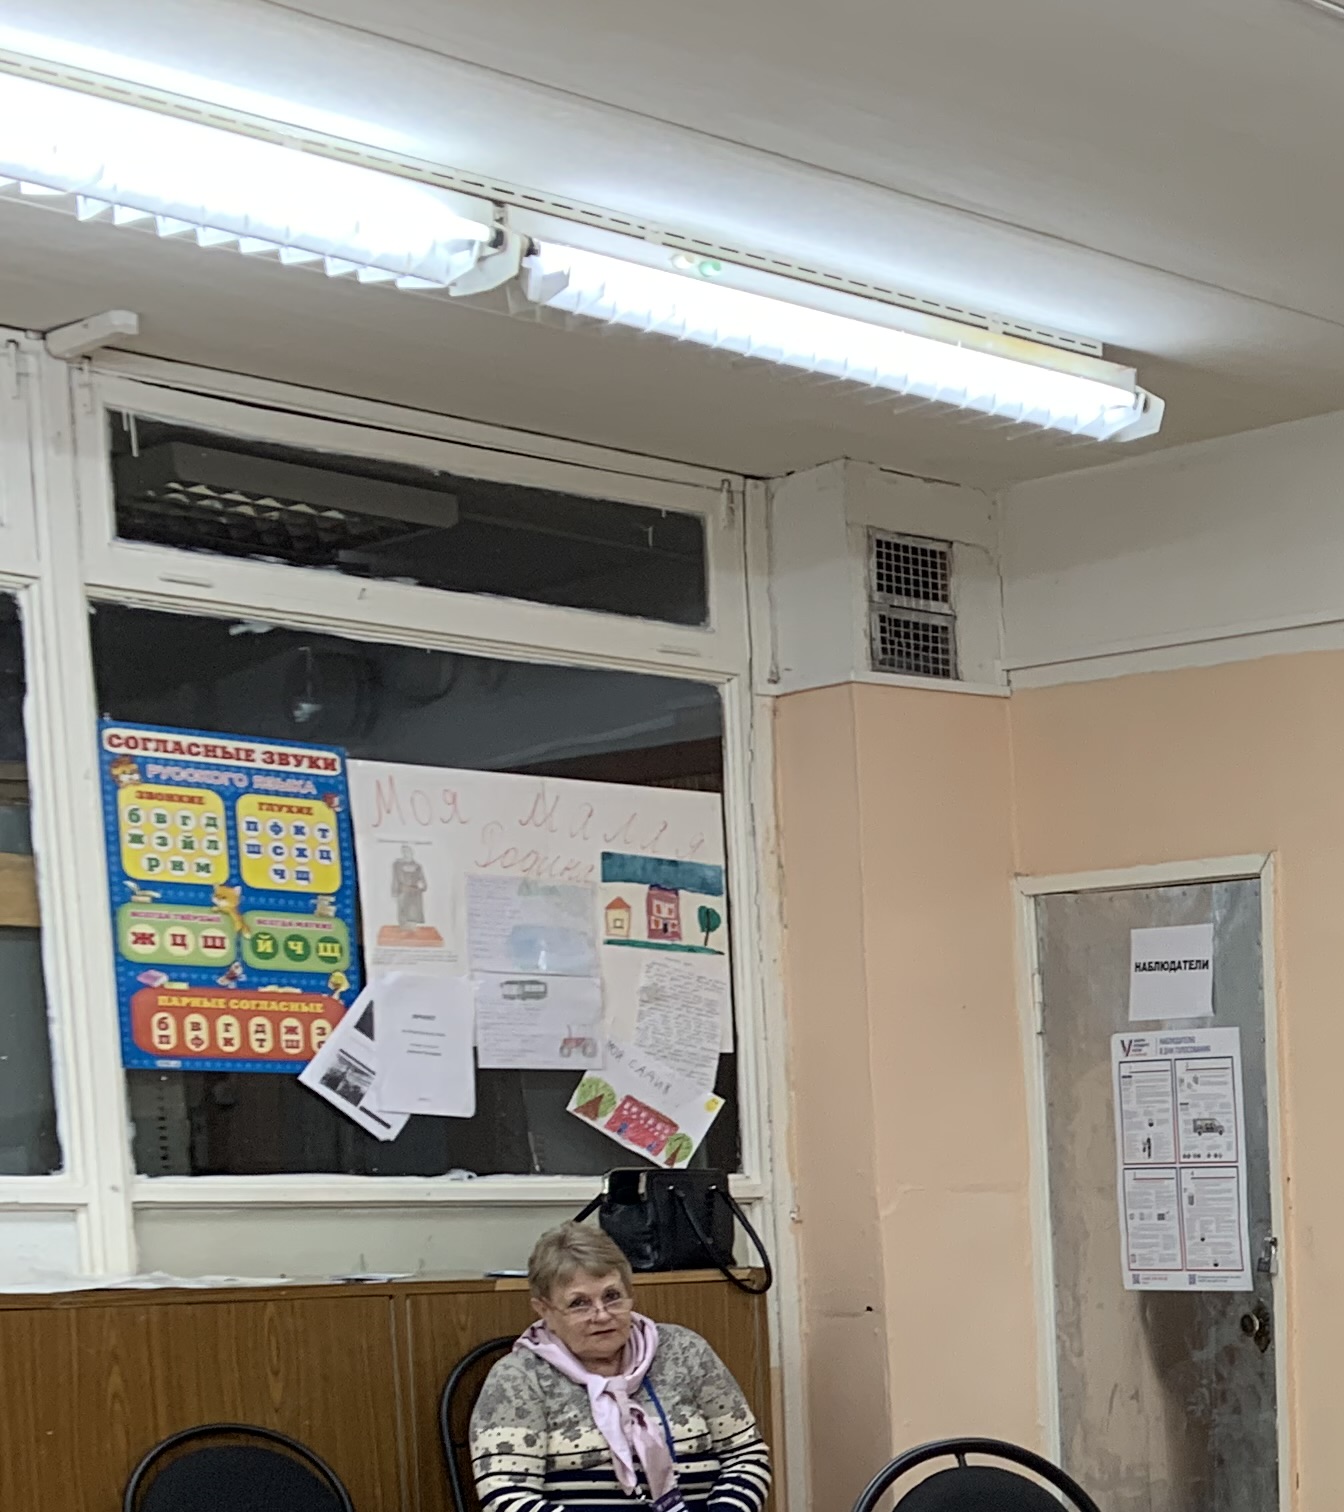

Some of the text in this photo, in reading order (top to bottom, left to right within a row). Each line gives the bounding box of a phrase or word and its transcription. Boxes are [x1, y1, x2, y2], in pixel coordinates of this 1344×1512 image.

[107, 733, 338, 772] СОГЛАСНЫЕ ЗВУКИ
[145, 763, 317, 795] РУССКОГО ЯЗЫКА
[1134, 959, 1210, 973] НАБЛЮДАТЕЛИ
[157, 995, 325, 1013] ПАРНЫЕ СОГЛАСНЫЕ
